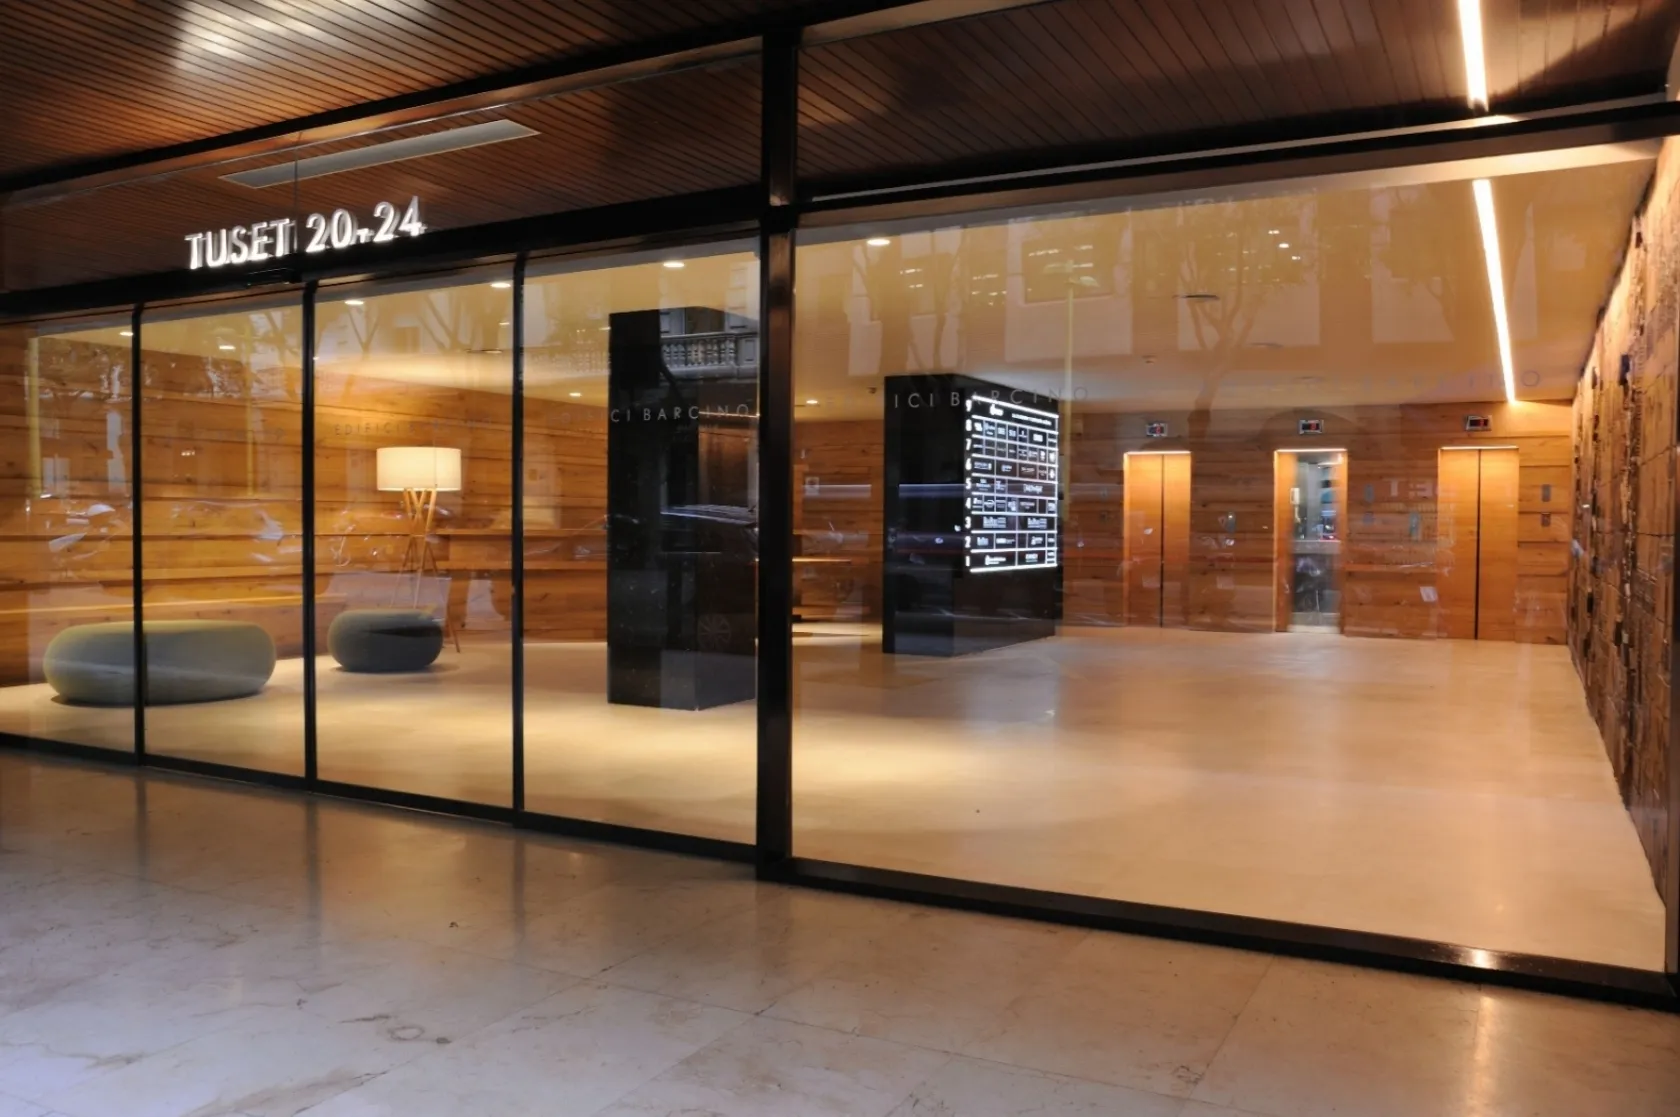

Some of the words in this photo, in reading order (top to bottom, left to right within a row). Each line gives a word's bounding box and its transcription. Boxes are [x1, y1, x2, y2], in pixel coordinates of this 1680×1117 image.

[184, 218, 291, 270] TUSET
[966, 400, 972, 412] 9
[643, 404, 749, 421] BARCINO
[966, 419, 972, 431] 8
[966, 439, 972, 451] 7
[965, 458, 972, 470] 6
[965, 478, 971, 490] 5
[965, 498, 971, 509] 4
[965, 517, 971, 528] 3
[965, 536, 971, 548] 2
[965, 556, 970, 566] 1
